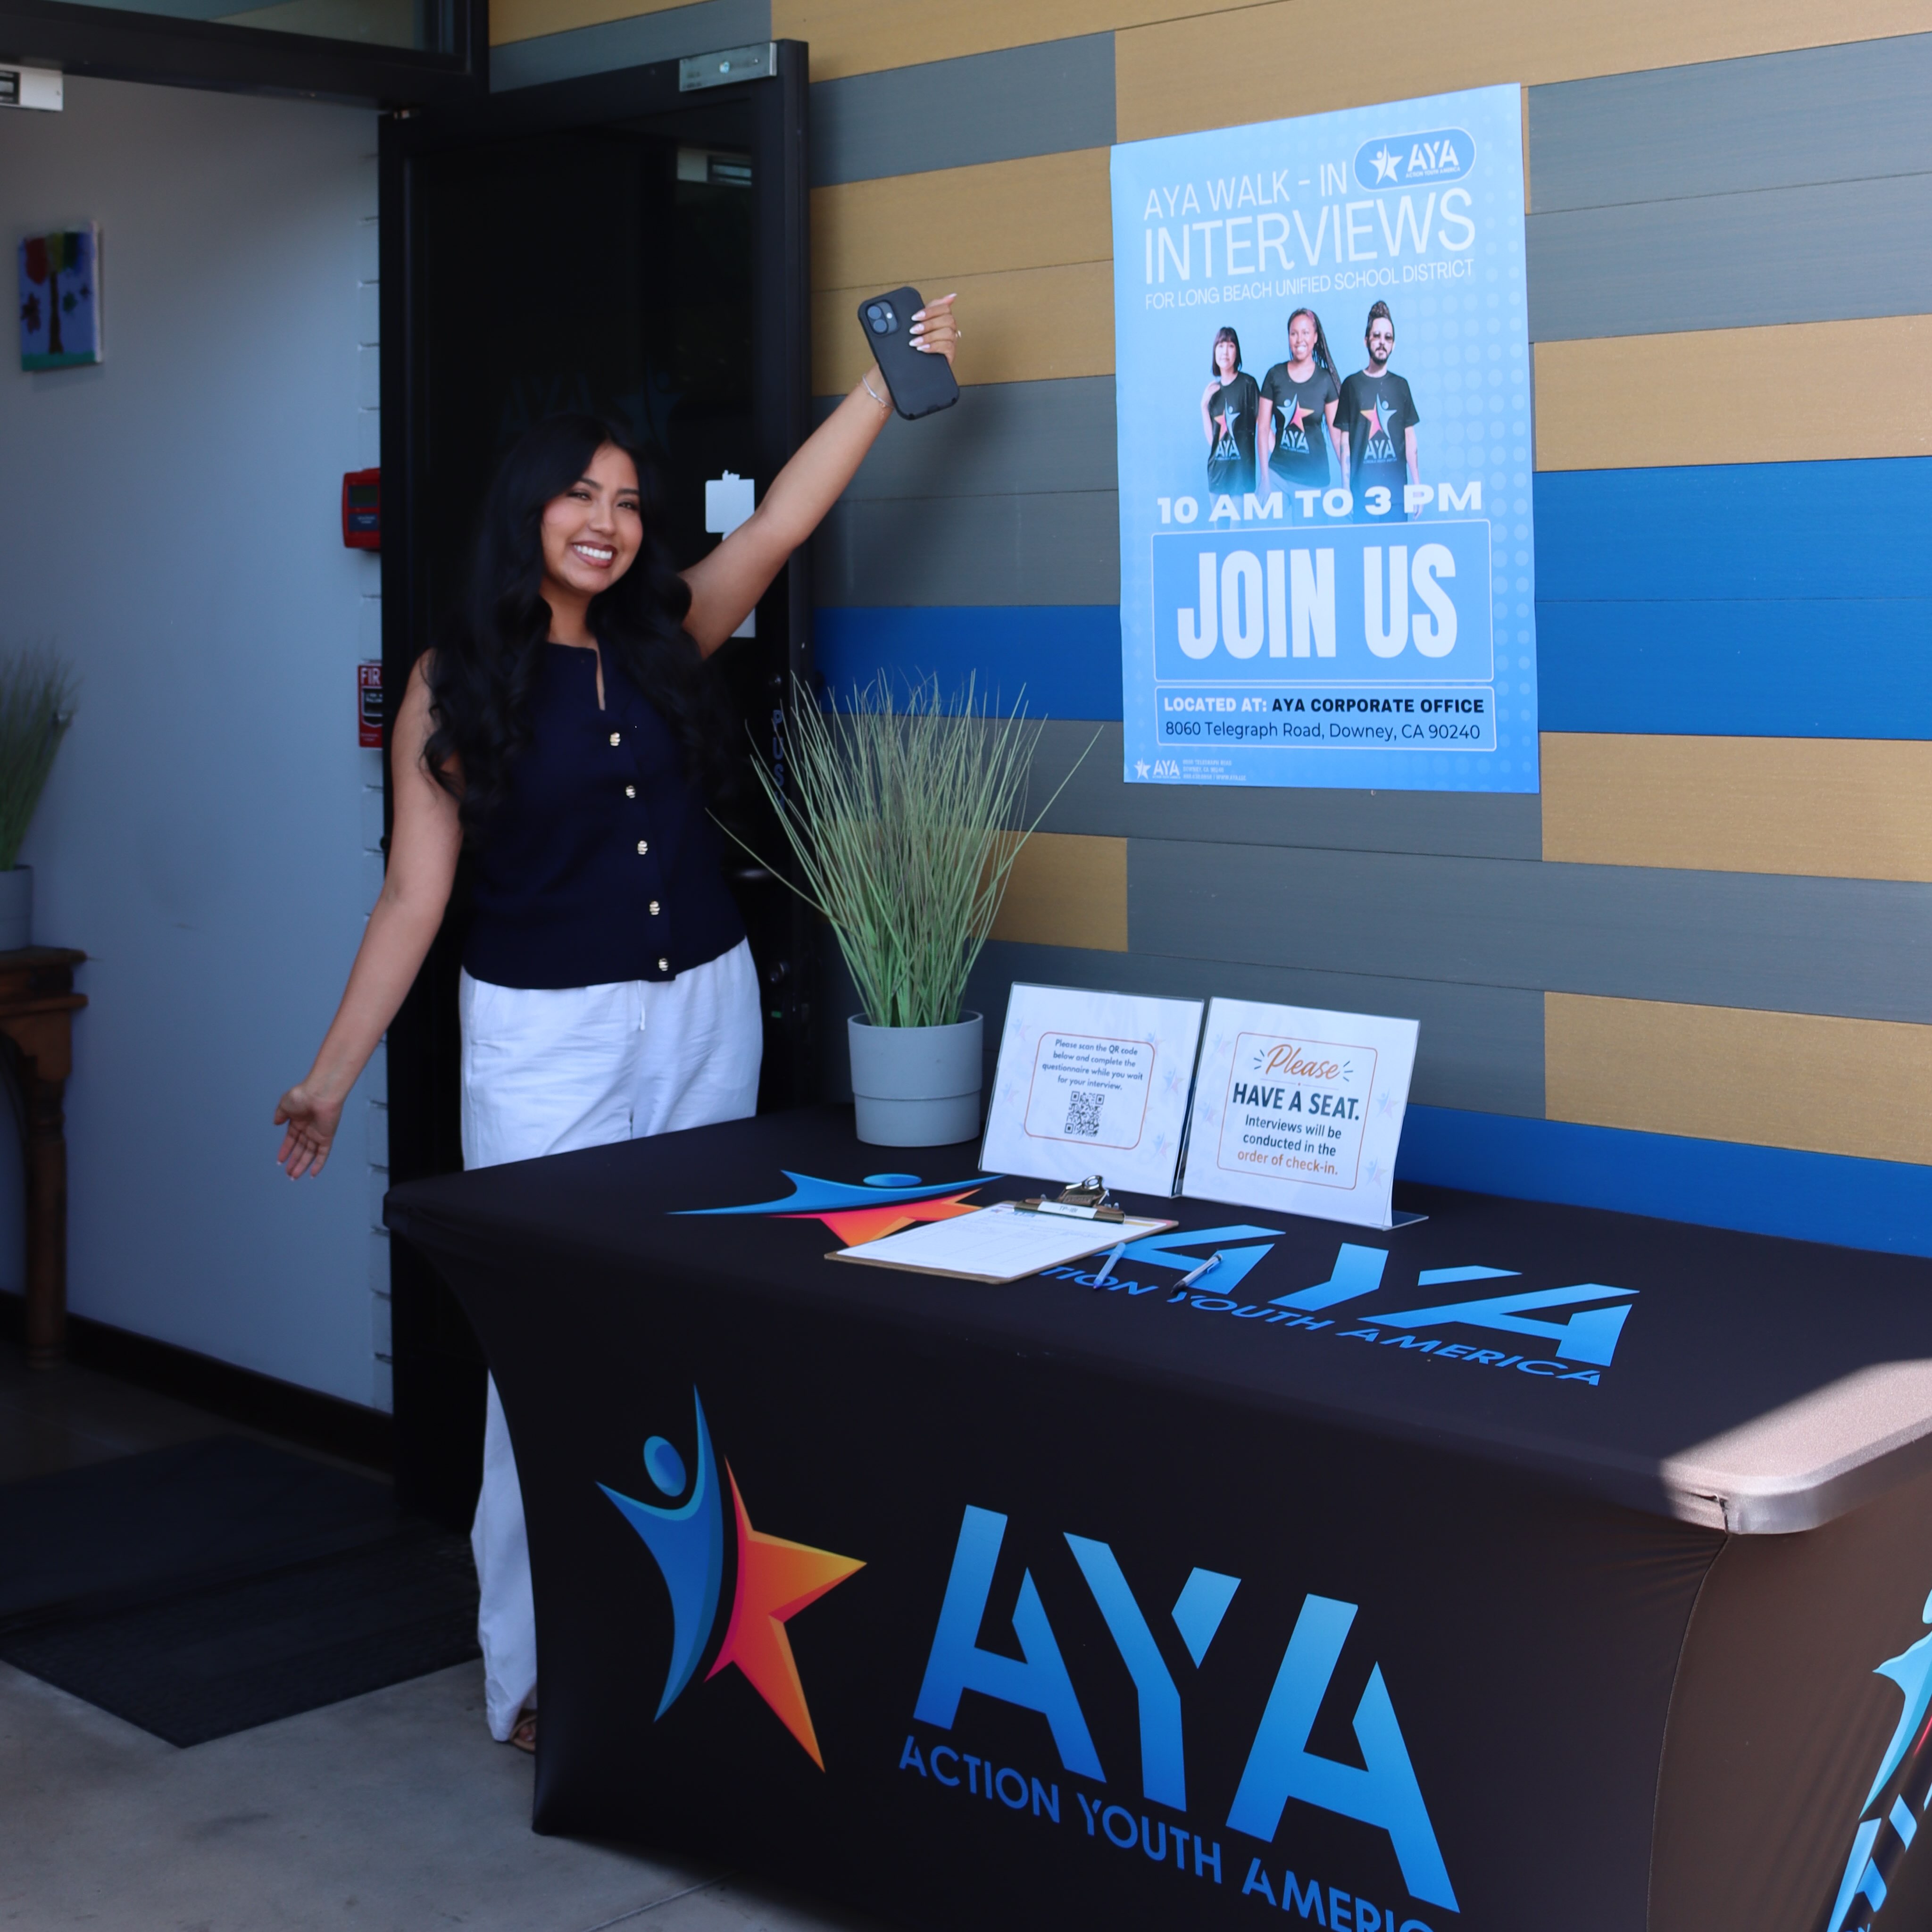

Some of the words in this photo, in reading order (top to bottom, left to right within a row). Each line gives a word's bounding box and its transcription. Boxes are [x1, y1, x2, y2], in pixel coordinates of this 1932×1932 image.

[1407, 140, 1459, 172] AYA
[1144, 183, 1200, 220] AYA
[1207, 169, 1290, 211] WALK
[1321, 161, 1347, 197] IN
[1145, 188, 1476, 284] INTERVIEWS
[1145, 290, 1174, 309] FOR
[1178, 286, 1220, 307] LONG
[1223, 282, 1272, 302] BEACH
[1276, 275, 1331, 298] UNIFIED
[1334, 268, 1399, 291] SCHOOL
[1403, 258, 1474, 283] DISTRICT
[1215, 440, 1240, 457] AYA
[1281, 430, 1308, 451] AYA
[1364, 440, 1396, 459] AYA
[1157, 496, 1199, 525] 10
[1208, 491, 1283, 522] AM
[1295, 489, 1353, 518] TO
[1365, 486, 1391, 515] 3
[1404, 481, 1482, 513] PM
[1177, 548, 1336, 659] JOIN
[1363, 543, 1457, 658] US
[360, 667, 381, 684] FIR
[1164, 697, 1236, 713] LOCATED
[1241, 698, 1267, 712] AT:
[1272, 699, 1306, 712] AYA
[1310, 698, 1415, 713] CORPORATE
[1420, 699, 1484, 714] OFFICE
[1165, 721, 1201, 736] 8060
[1204, 721, 1278, 740] Telegraph
[1282, 722, 1326, 740] Road,
[1329, 724, 1397, 741] Downey,
[1401, 724, 1424, 739] CA
[1428, 724, 1481, 740] 90240
[1153, 759, 1180, 776] AYA
[1053, 1050, 1074, 1060] below
[1091, 1057, 1123, 1066] complete
[1055, 1039, 1077, 1049] Please
[1096, 1044, 1107, 1052] the
[1109, 1045, 1119, 1054] QR
[1121, 1048, 1138, 1056] code
[1042, 1063, 1089, 1074] questionnaire
[1091, 1067, 1110, 1076] while
[1127, 1072, 1143, 1081] wait
[1266, 1044, 1340, 1080] Please
[1058, 1075, 1067, 1083] for
[1087, 1079, 1122, 1091] interview.
[1232, 1083, 1285, 1110] HAVE
[1288, 1091, 1301, 1112] A
[1308, 1093, 1359, 1121] SEAT.
[1245, 1114, 1302, 1133] Interviews
[1305, 1124, 1325, 1137] will
[1328, 1126, 1341, 1139] be
[1243, 1134, 1301, 1151] conducted
[1305, 1140, 1314, 1153] in
[1318, 1143, 1336, 1157] the
[1238, 1150, 1268, 1164] order
[1271, 1154, 1284, 1166] of
[1286, 1156, 1338, 1175] check-in.
[1093, 1224, 1640, 1367] AYA
[1166, 1292, 1335, 1331] YOUTH
[1336, 1329, 1601, 1385] AMERICA
[913, 1504, 1460, 1913] AYA
[899, 1735, 1059, 1823] ACTION
[1077, 1793, 1221, 1883] YOUTH
